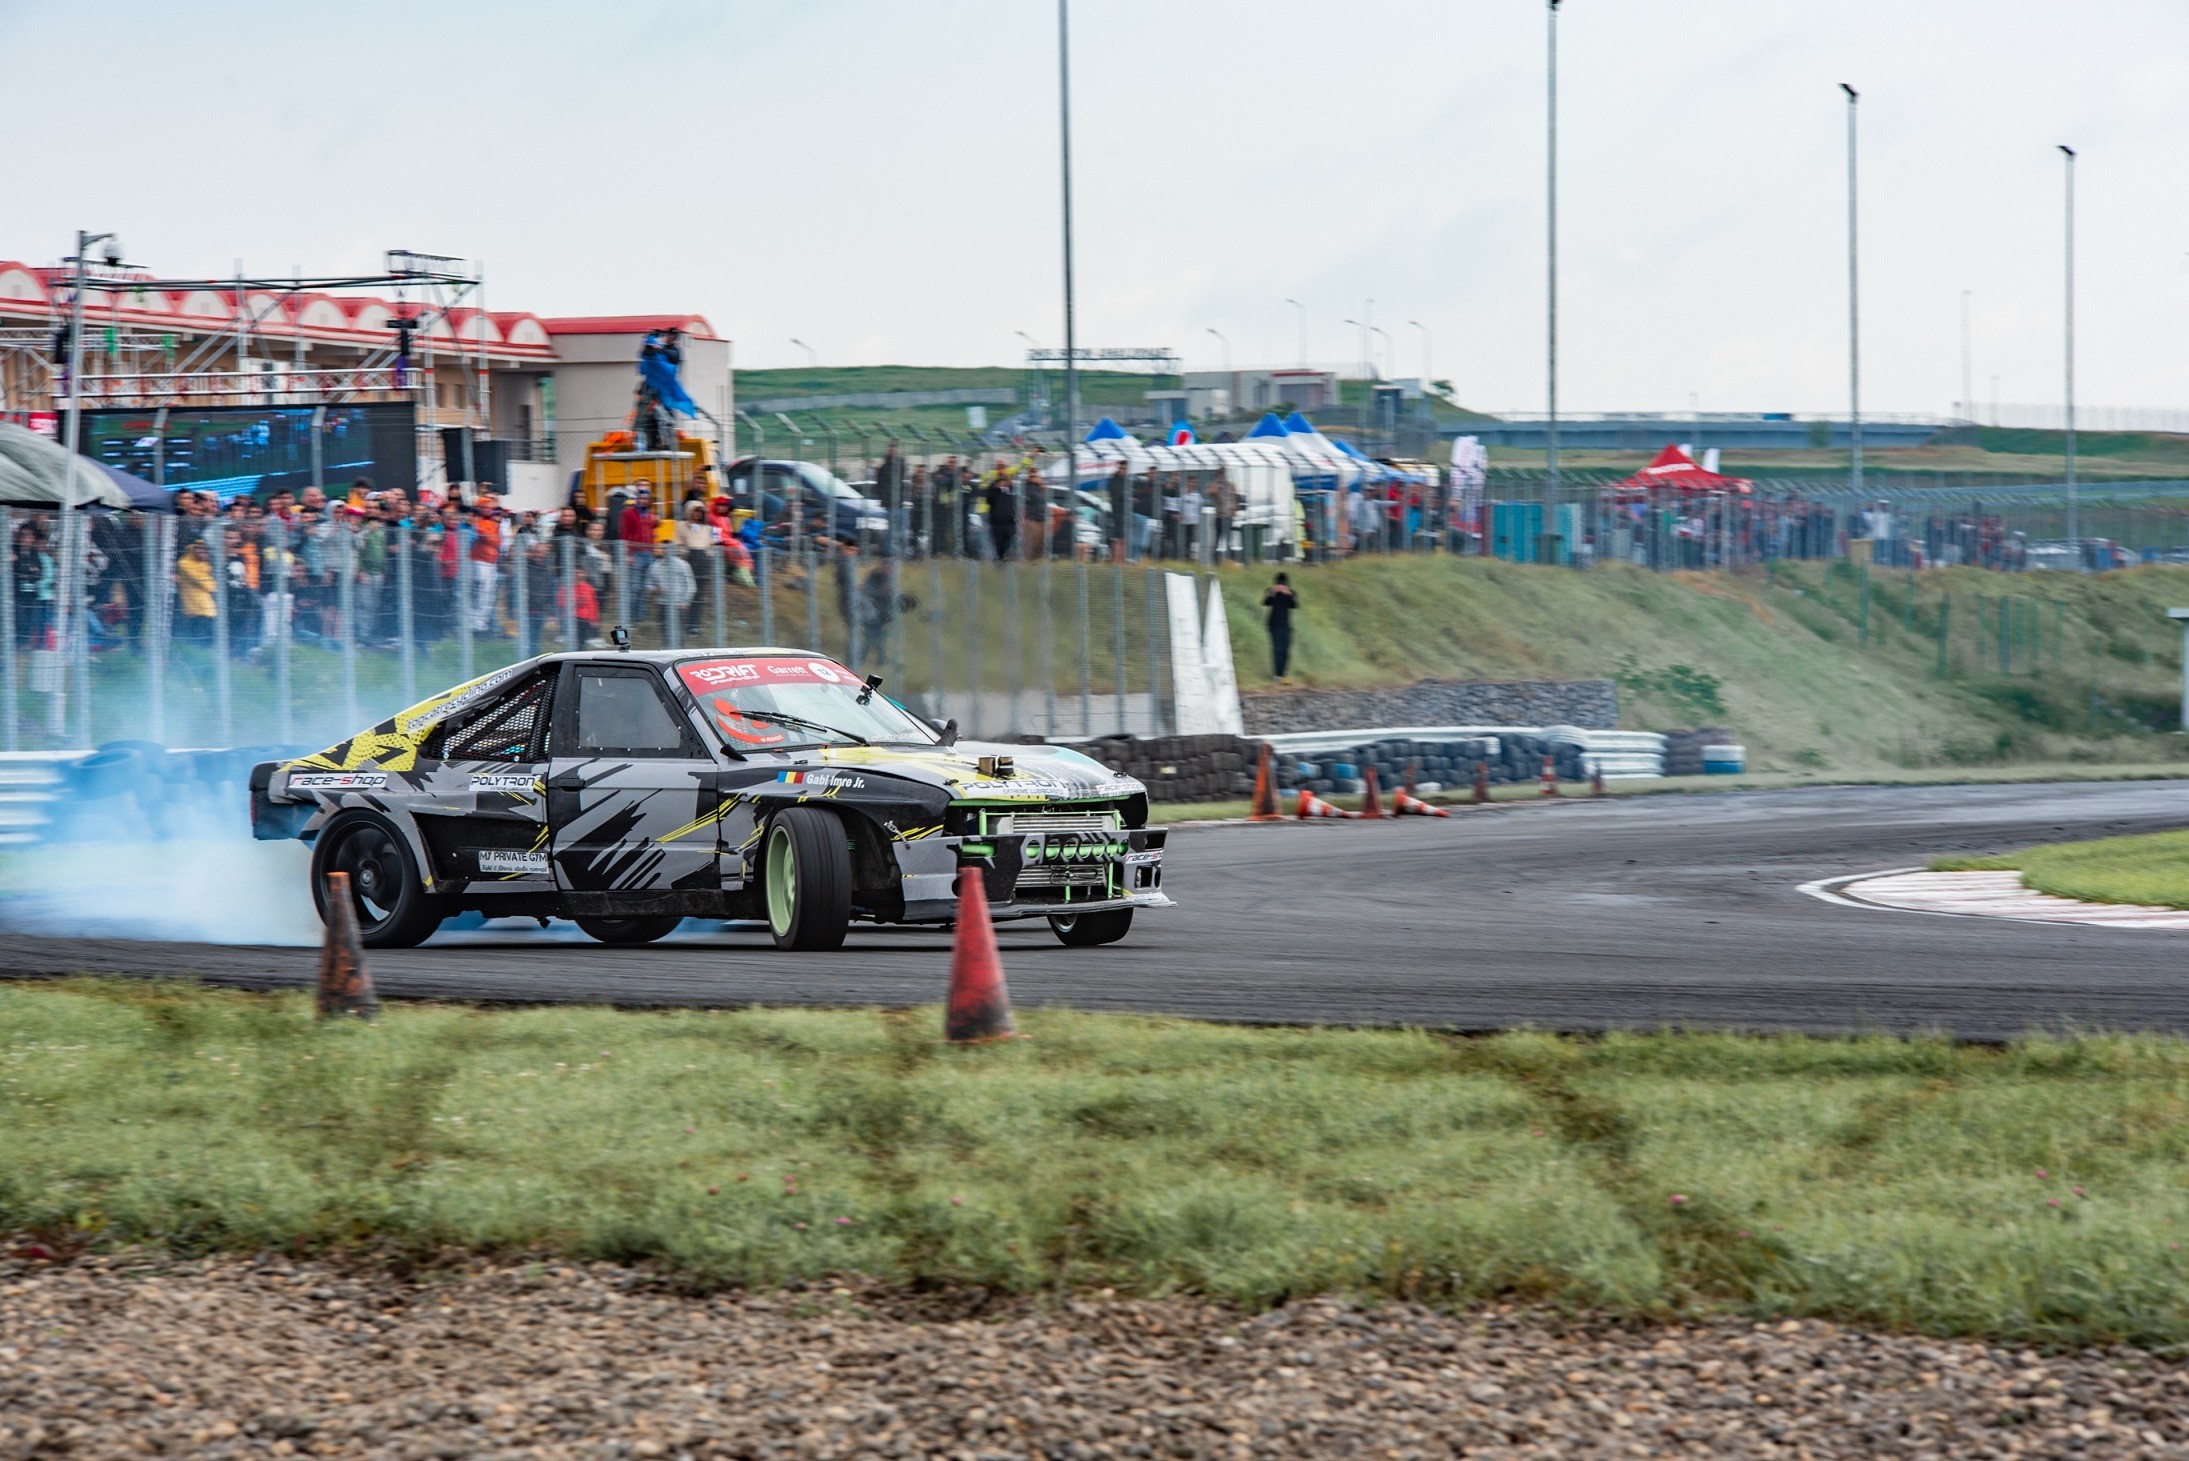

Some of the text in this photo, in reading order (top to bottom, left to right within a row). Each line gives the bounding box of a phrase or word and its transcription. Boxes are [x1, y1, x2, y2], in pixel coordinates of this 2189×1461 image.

[767, 665, 808, 674] Garrett
[817, 668, 831, 676] 12
[290, 774, 386, 786] race-shop
[471, 776, 535, 786] POLYTRON
[806, 773, 865, 788] Gabi Imre Jr.
[480, 851, 547, 862] MY PRIVATE GYM
